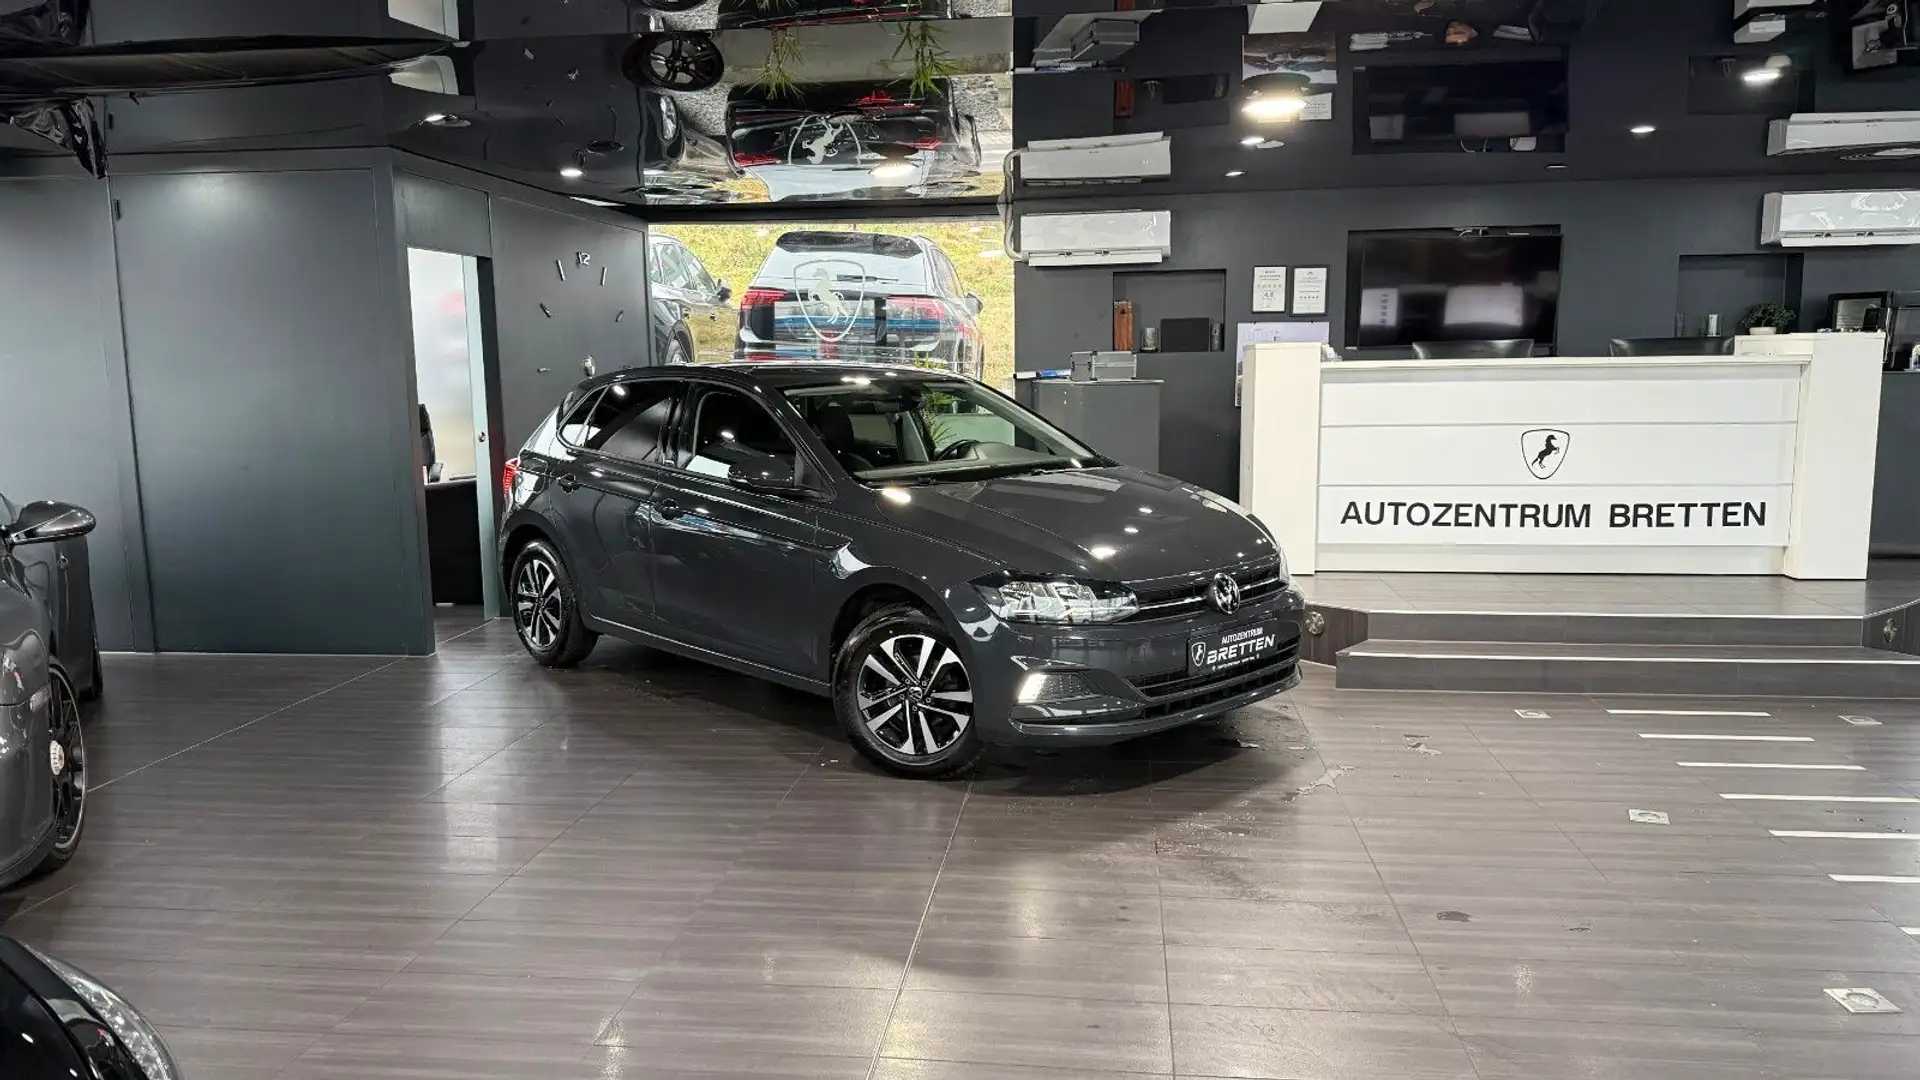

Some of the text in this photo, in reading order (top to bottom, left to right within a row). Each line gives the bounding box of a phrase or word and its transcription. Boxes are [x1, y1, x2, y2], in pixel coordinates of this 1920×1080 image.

[577, 251, 590, 265] 12
[1340, 501, 1766, 528] AUTOZENTRUM BRETTEN
[1221, 626, 1264, 644] AUTOZENTRUM
[1206, 633, 1276, 665] BRETTEN
